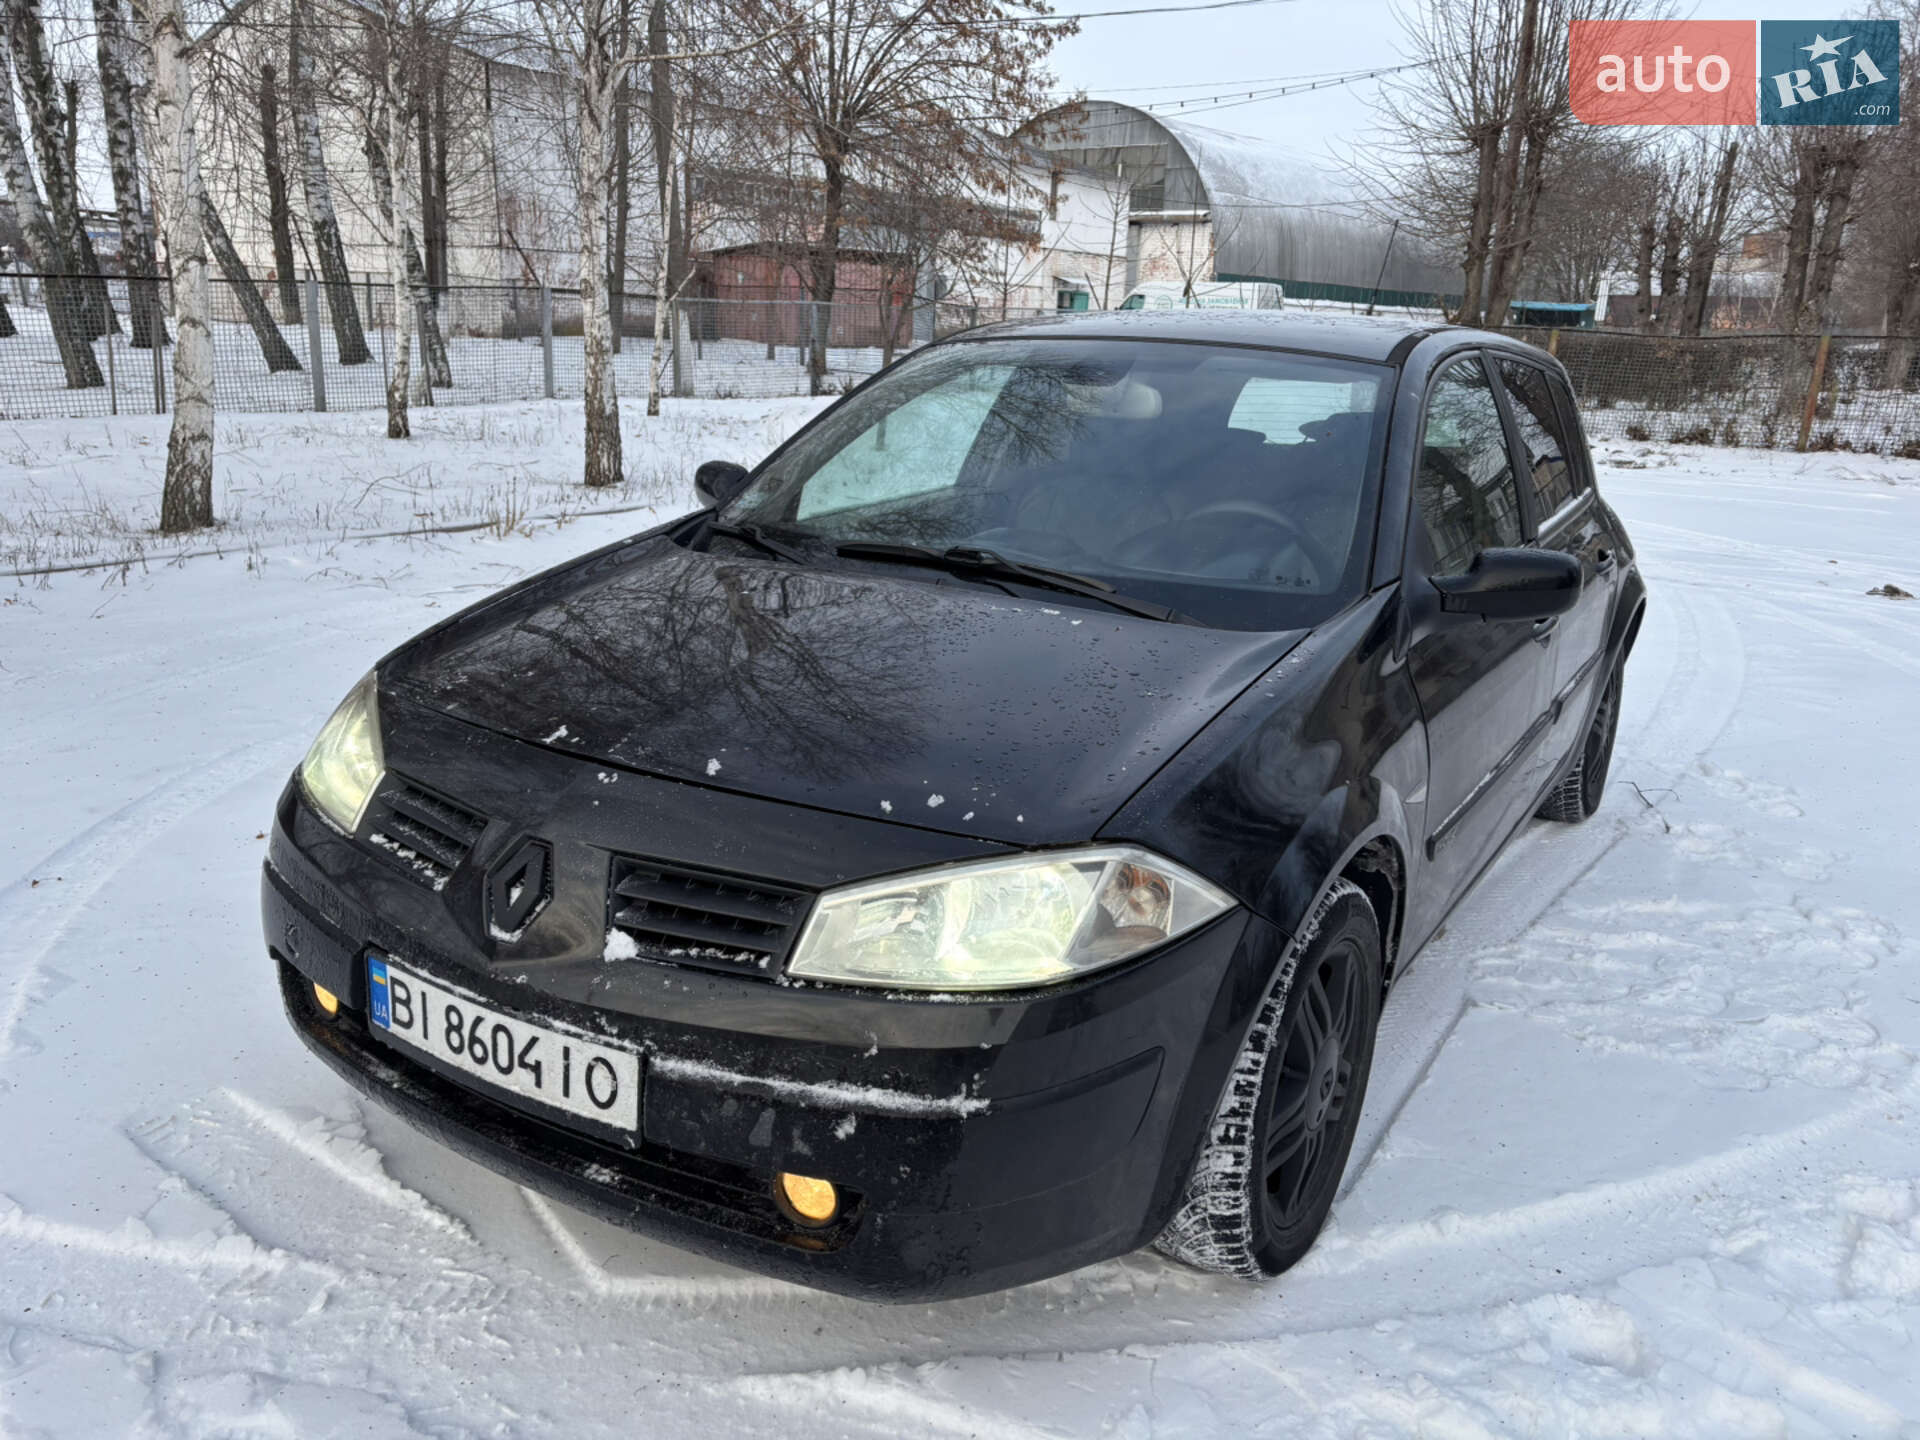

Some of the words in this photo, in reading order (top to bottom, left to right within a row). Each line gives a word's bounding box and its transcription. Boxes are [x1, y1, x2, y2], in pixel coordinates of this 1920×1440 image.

[374, 1000, 388, 1020] UA
[389, 975, 429, 1040] BI
[444, 1004, 542, 1089] 8604
[562, 1045, 618, 1110] IO
